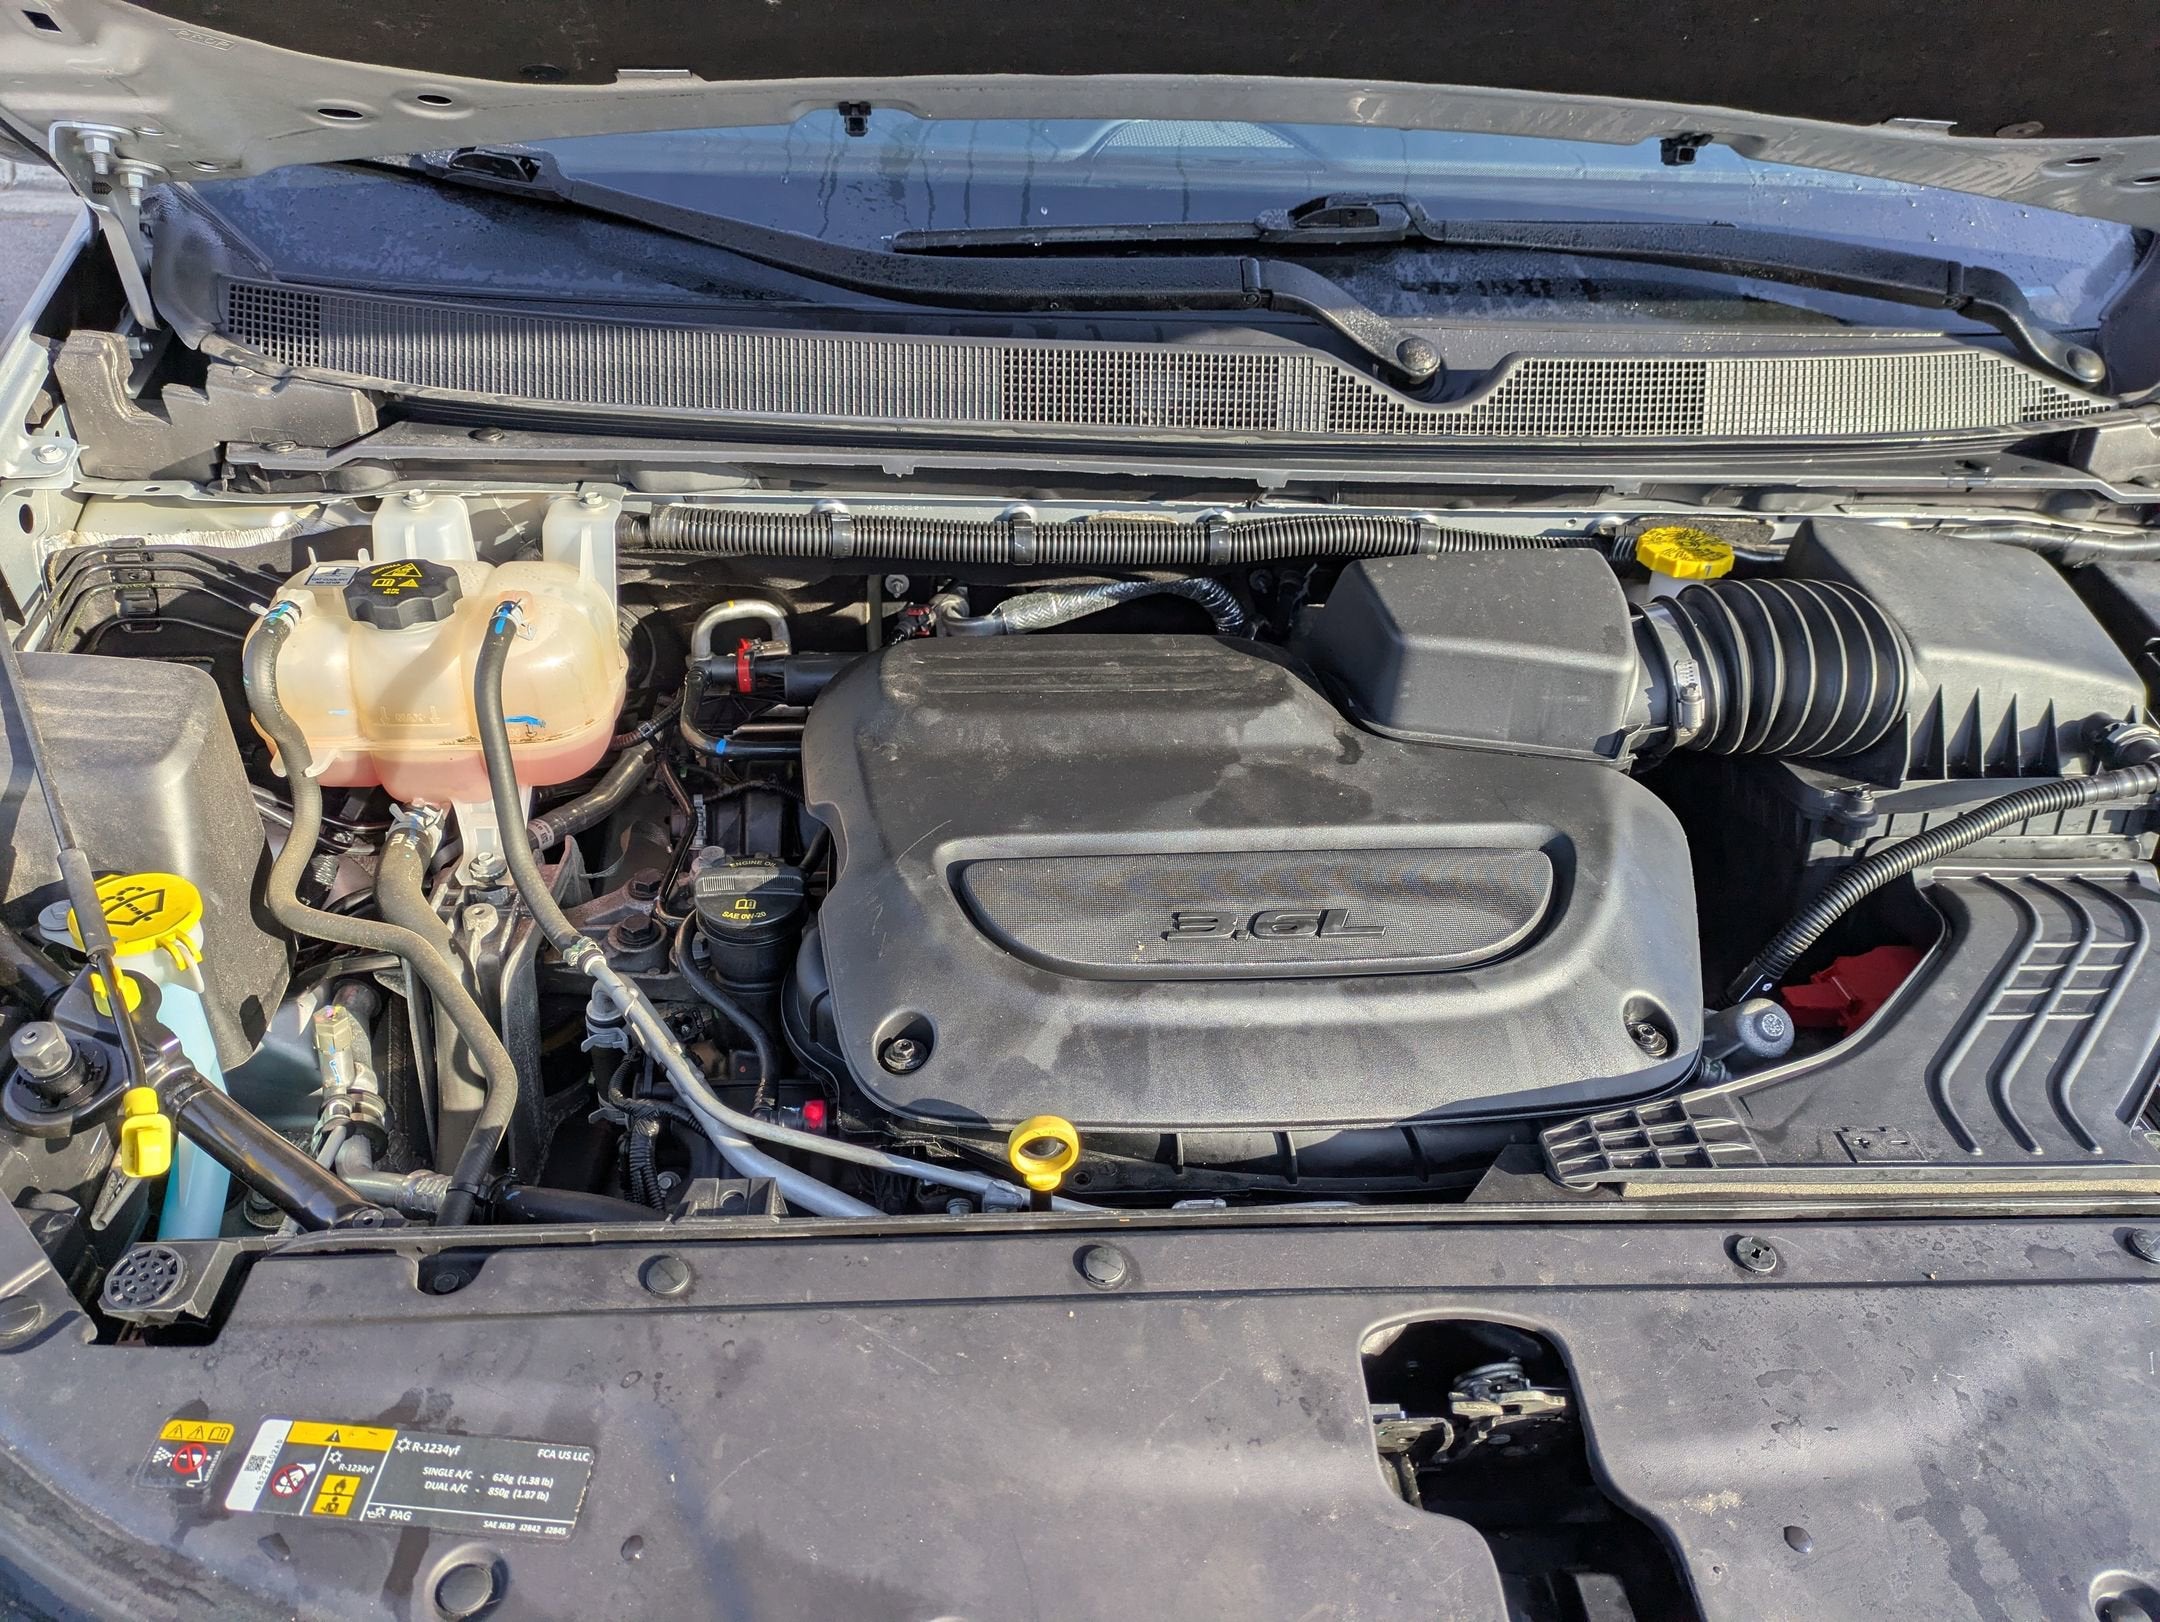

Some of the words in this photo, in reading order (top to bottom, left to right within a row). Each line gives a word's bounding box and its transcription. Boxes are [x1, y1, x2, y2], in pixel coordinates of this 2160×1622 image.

[721, 911, 740, 920] SAE
[1161, 908, 1387, 943] 3.6L
[411, 1442, 461, 1457] R-1234yf
[537, 1448, 556, 1459] FCA
[558, 1450, 572, 1461] US
[573, 1452, 590, 1462] LLC
[338, 1462, 375, 1475] R-1234yf
[422, 1466, 454, 1478] SINGLE
[455, 1469, 473, 1480] A/C
[492, 1473, 515, 1485] 624g
[517, 1475, 541, 1487] (1.38
[541, 1477, 555, 1489] lb)
[424, 1481, 449, 1491] DUAL
[450, 1483, 468, 1493] A/C
[488, 1487, 510, 1499] 850g
[512, 1489, 536, 1500] (1.87
[536, 1491, 550, 1504] lb)
[389, 1509, 413, 1521] PAG
[483, 1520, 497, 1529] SAE
